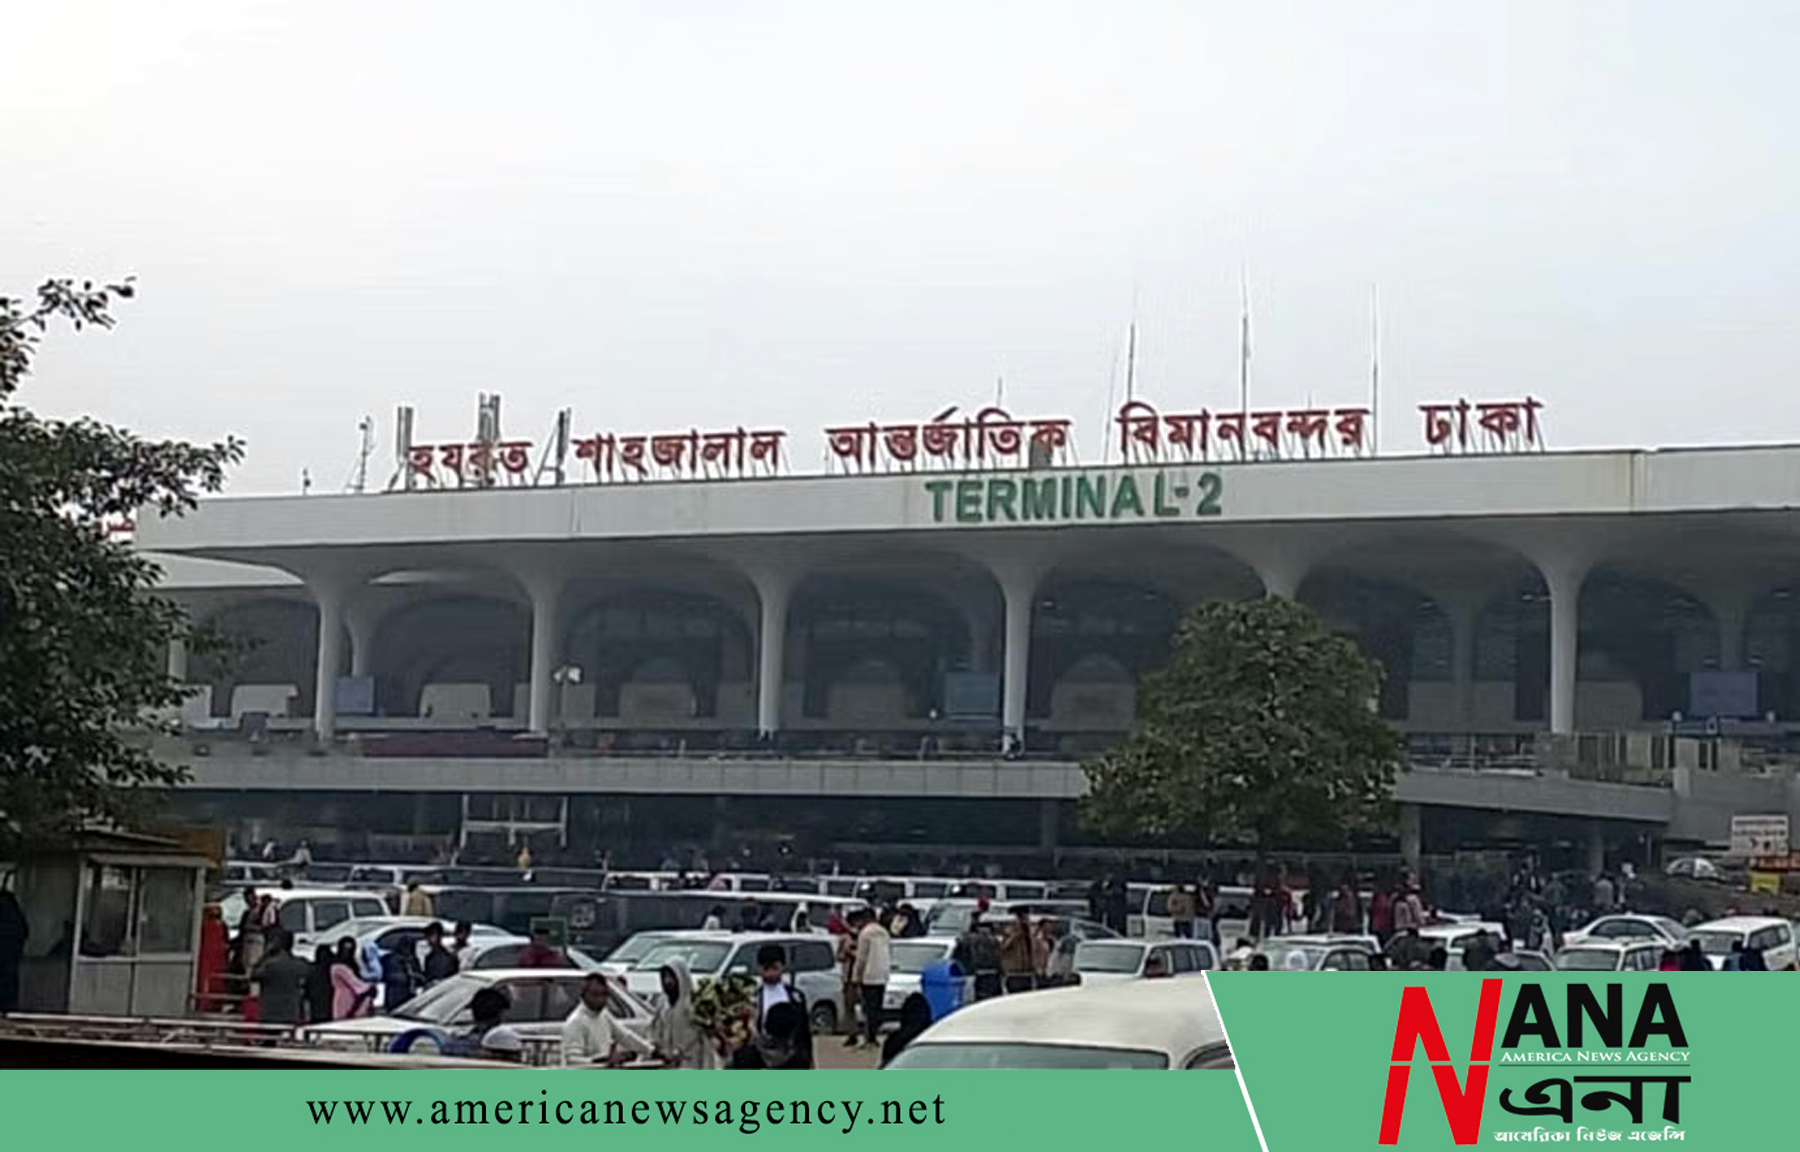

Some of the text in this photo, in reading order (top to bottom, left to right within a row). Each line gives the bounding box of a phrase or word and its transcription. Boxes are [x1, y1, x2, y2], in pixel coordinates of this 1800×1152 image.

[408, 396, 1542, 483] হযরত শাহজালাল আন্তর্জাতিক বিমানবন্দর ঢাকা
